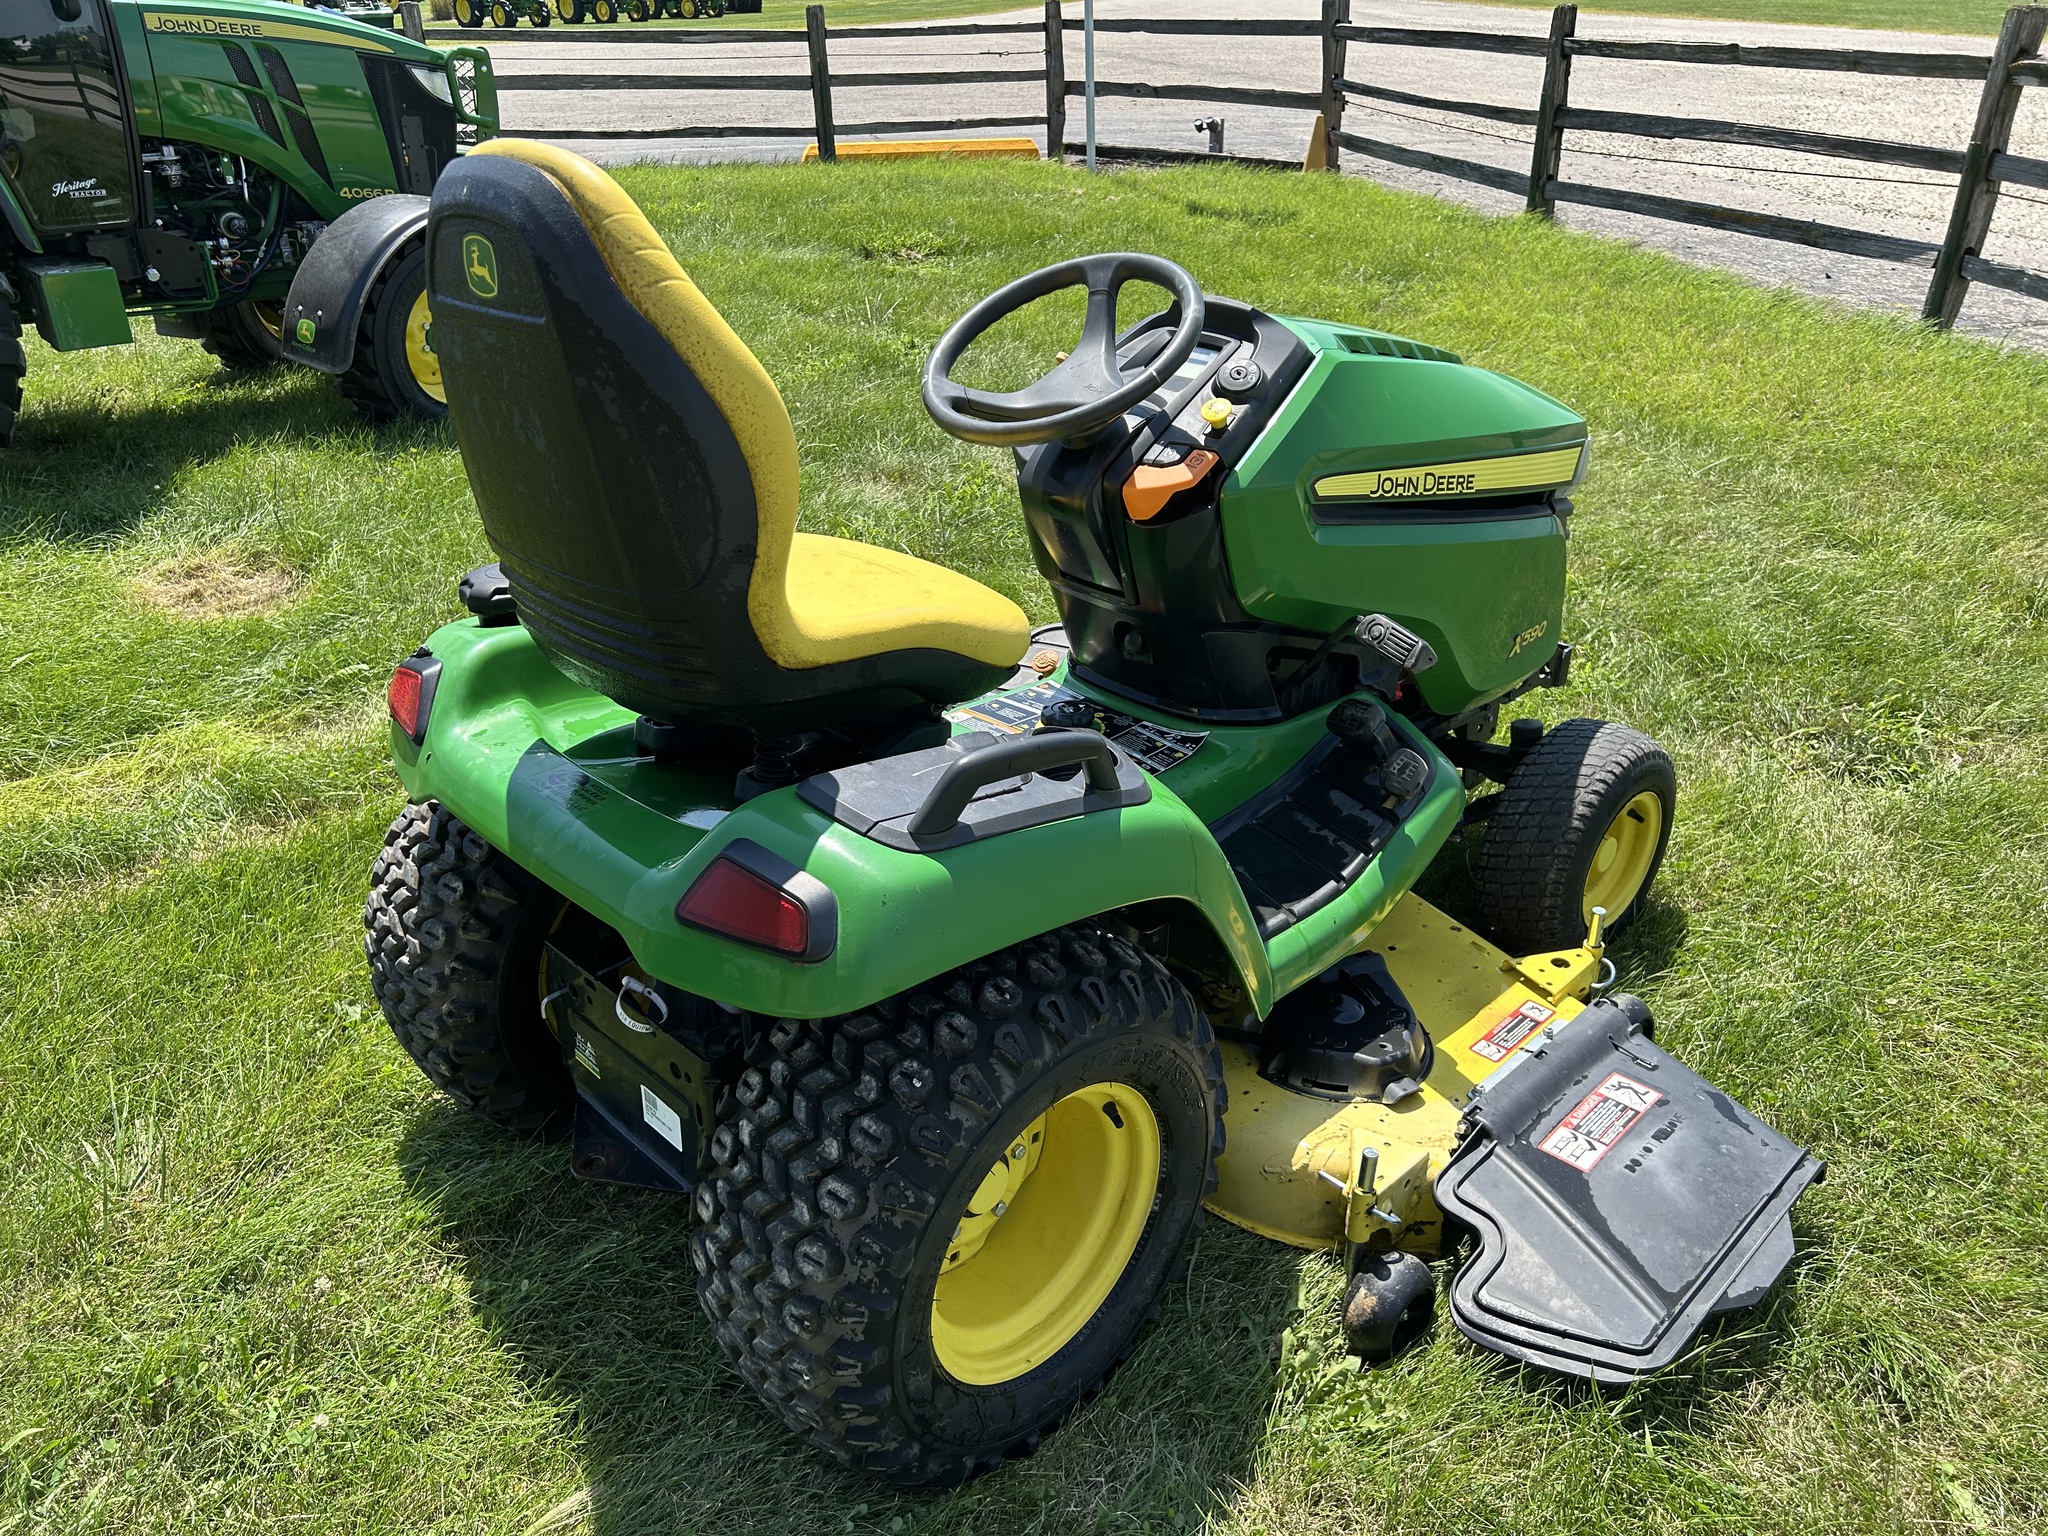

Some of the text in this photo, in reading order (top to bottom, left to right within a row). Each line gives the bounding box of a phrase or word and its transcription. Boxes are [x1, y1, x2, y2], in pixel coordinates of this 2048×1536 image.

[153, 16, 262, 35] JOHN DEERE
[52, 178, 97, 197] Heritage
[70, 189, 107, 198] TRACTOR
[1369, 472, 1476, 496] JOHN DEERE
[1506, 620, 1548, 660] X590
[1573, 1094, 1600, 1118] DANGER
[1636, 1140, 1658, 1160] NOT
